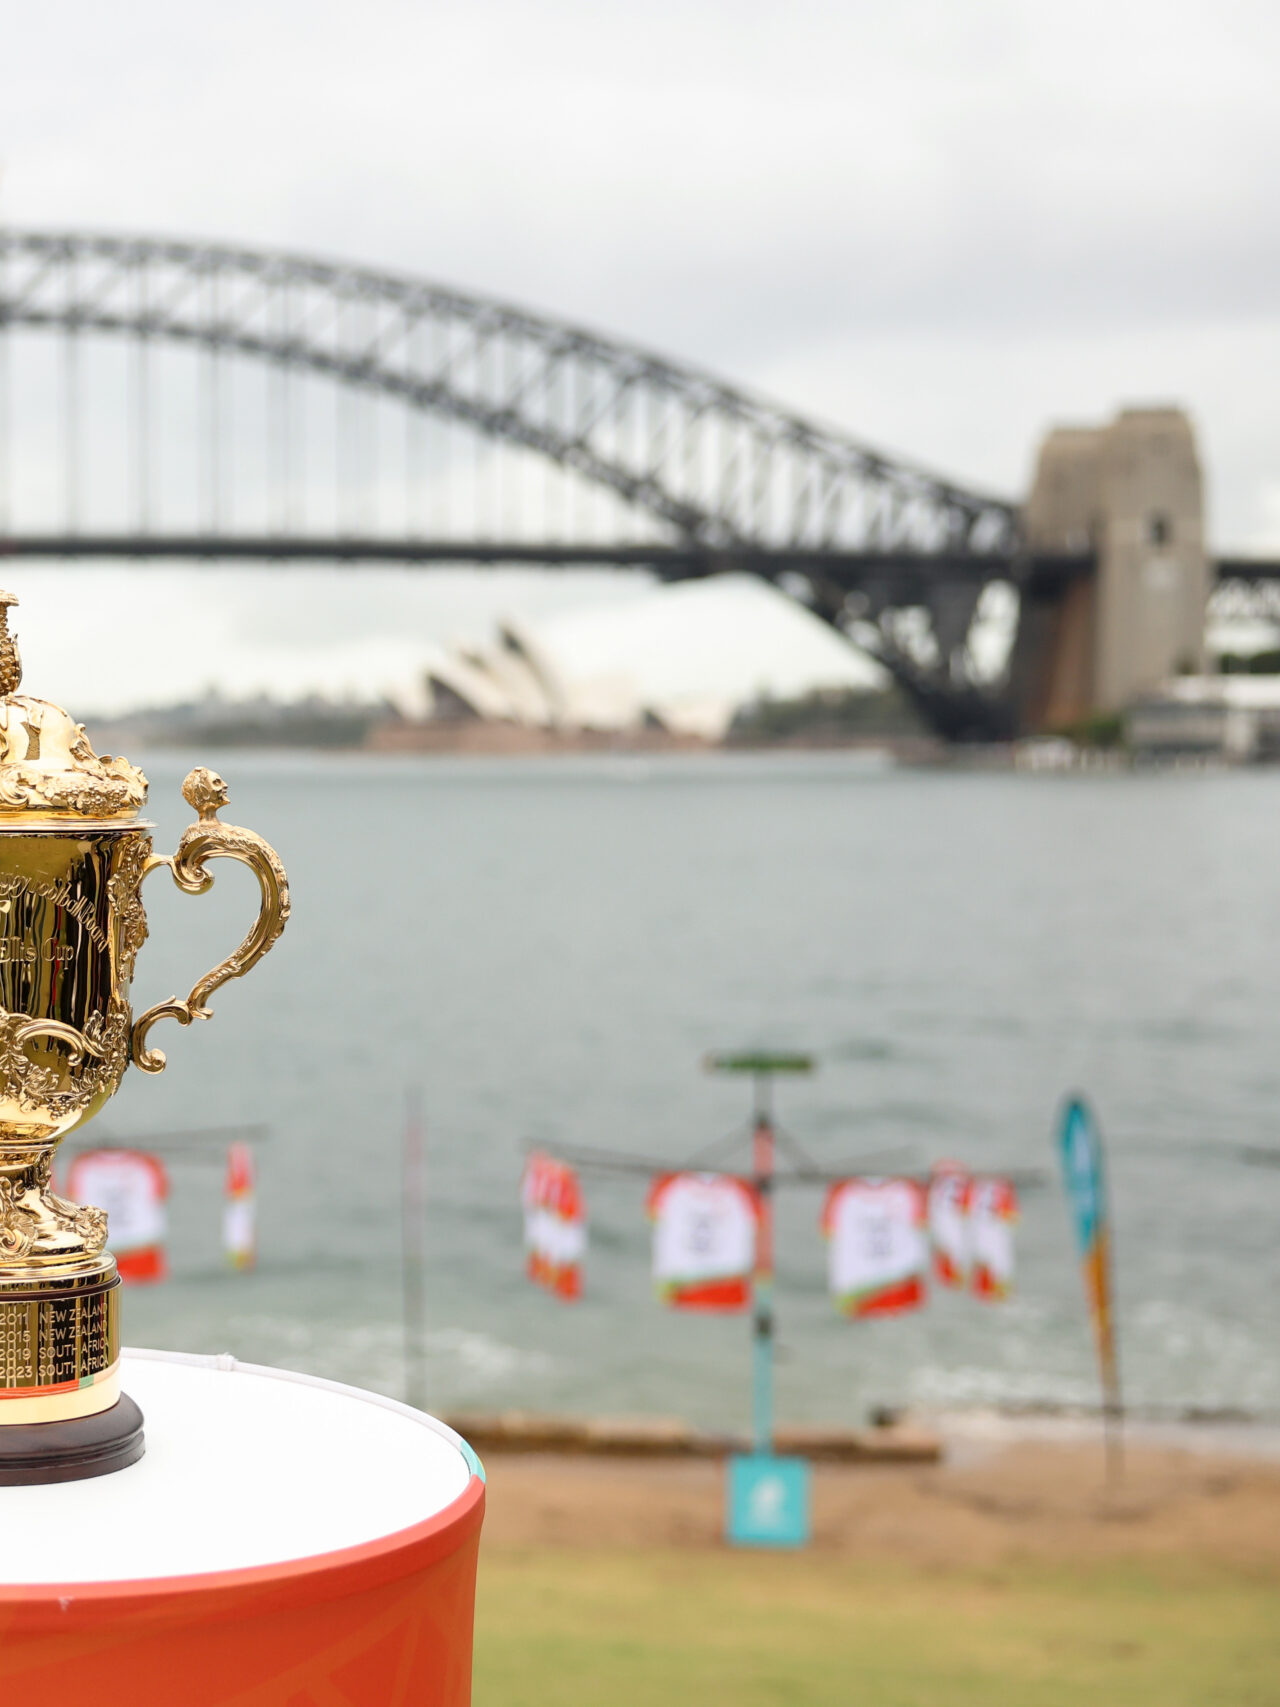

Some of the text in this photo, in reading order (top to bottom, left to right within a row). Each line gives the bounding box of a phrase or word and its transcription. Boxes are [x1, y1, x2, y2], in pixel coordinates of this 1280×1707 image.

[77, 900, 109, 954] Board
[42, 936, 75, 970] Cup
[39, 1310, 67, 1324] NEW
[68, 1303, 107, 1321] ZEALAND
[39, 1327, 67, 1342] NEW
[68, 1320, 107, 1338] ZEALAND
[38, 1344, 78, 1360] SOUTH
[80, 1337, 109, 1354] AFRICA
[38, 1361, 78, 1376] SOUTH
[80, 1354, 109, 1372] AFRICA
